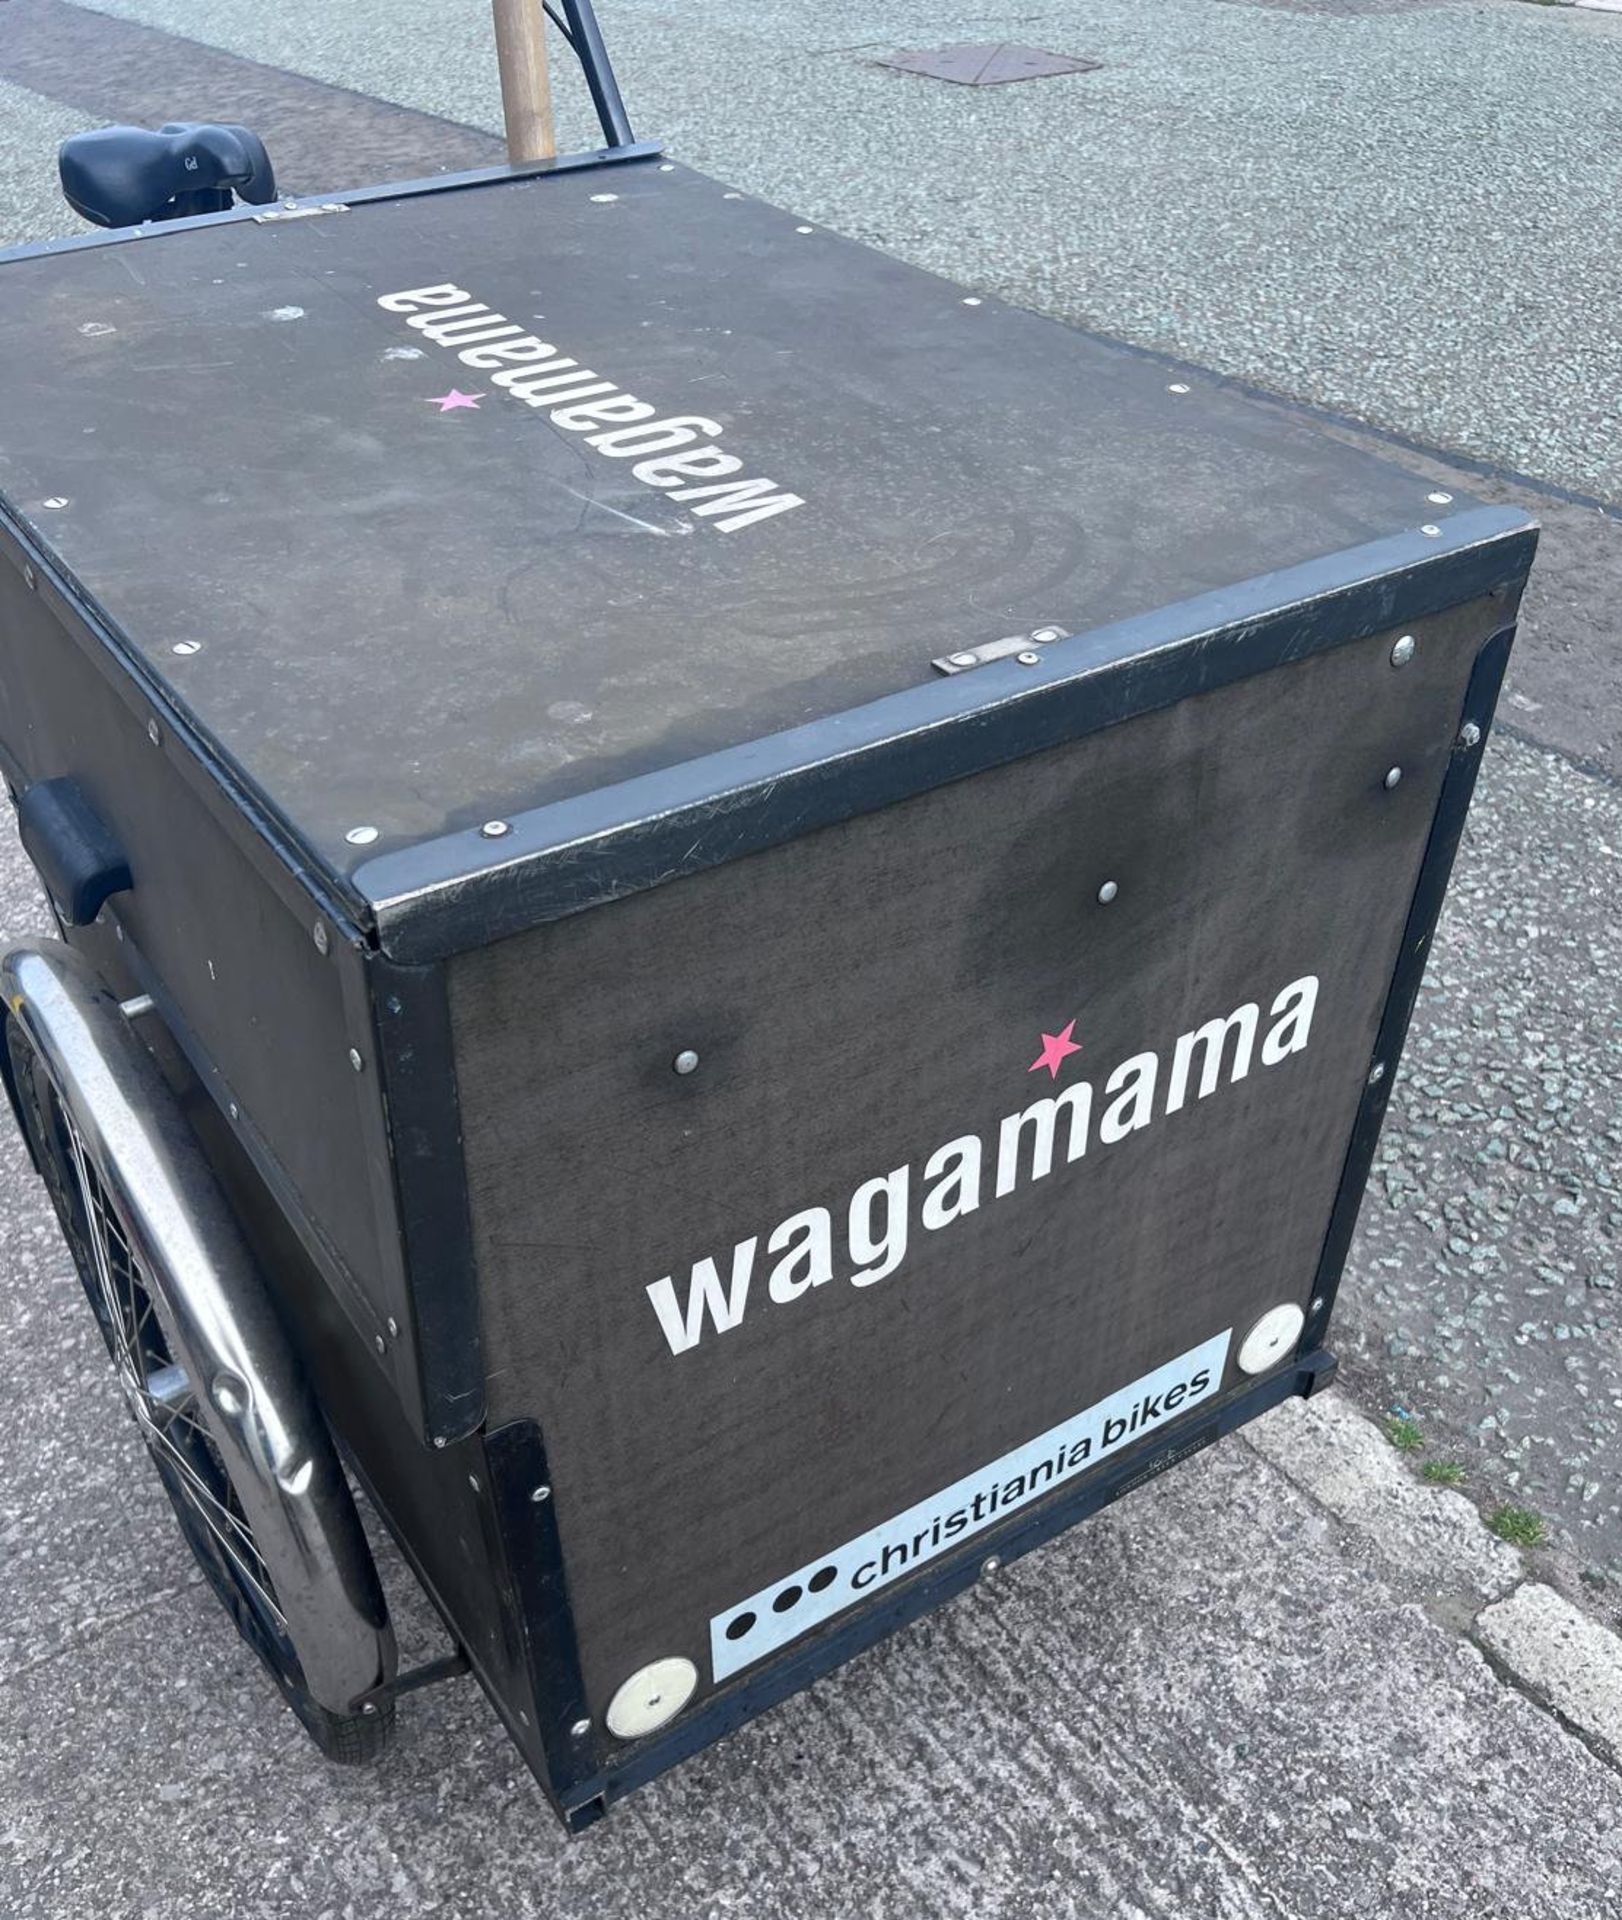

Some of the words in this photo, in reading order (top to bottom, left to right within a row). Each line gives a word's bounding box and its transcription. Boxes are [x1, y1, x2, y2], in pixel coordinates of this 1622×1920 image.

[377, 283, 806, 533] wagamama
[646, 976, 1318, 1355] wagamama
[850, 1438, 1092, 1590] christiania
[1102, 1367, 1210, 1448] bikes
